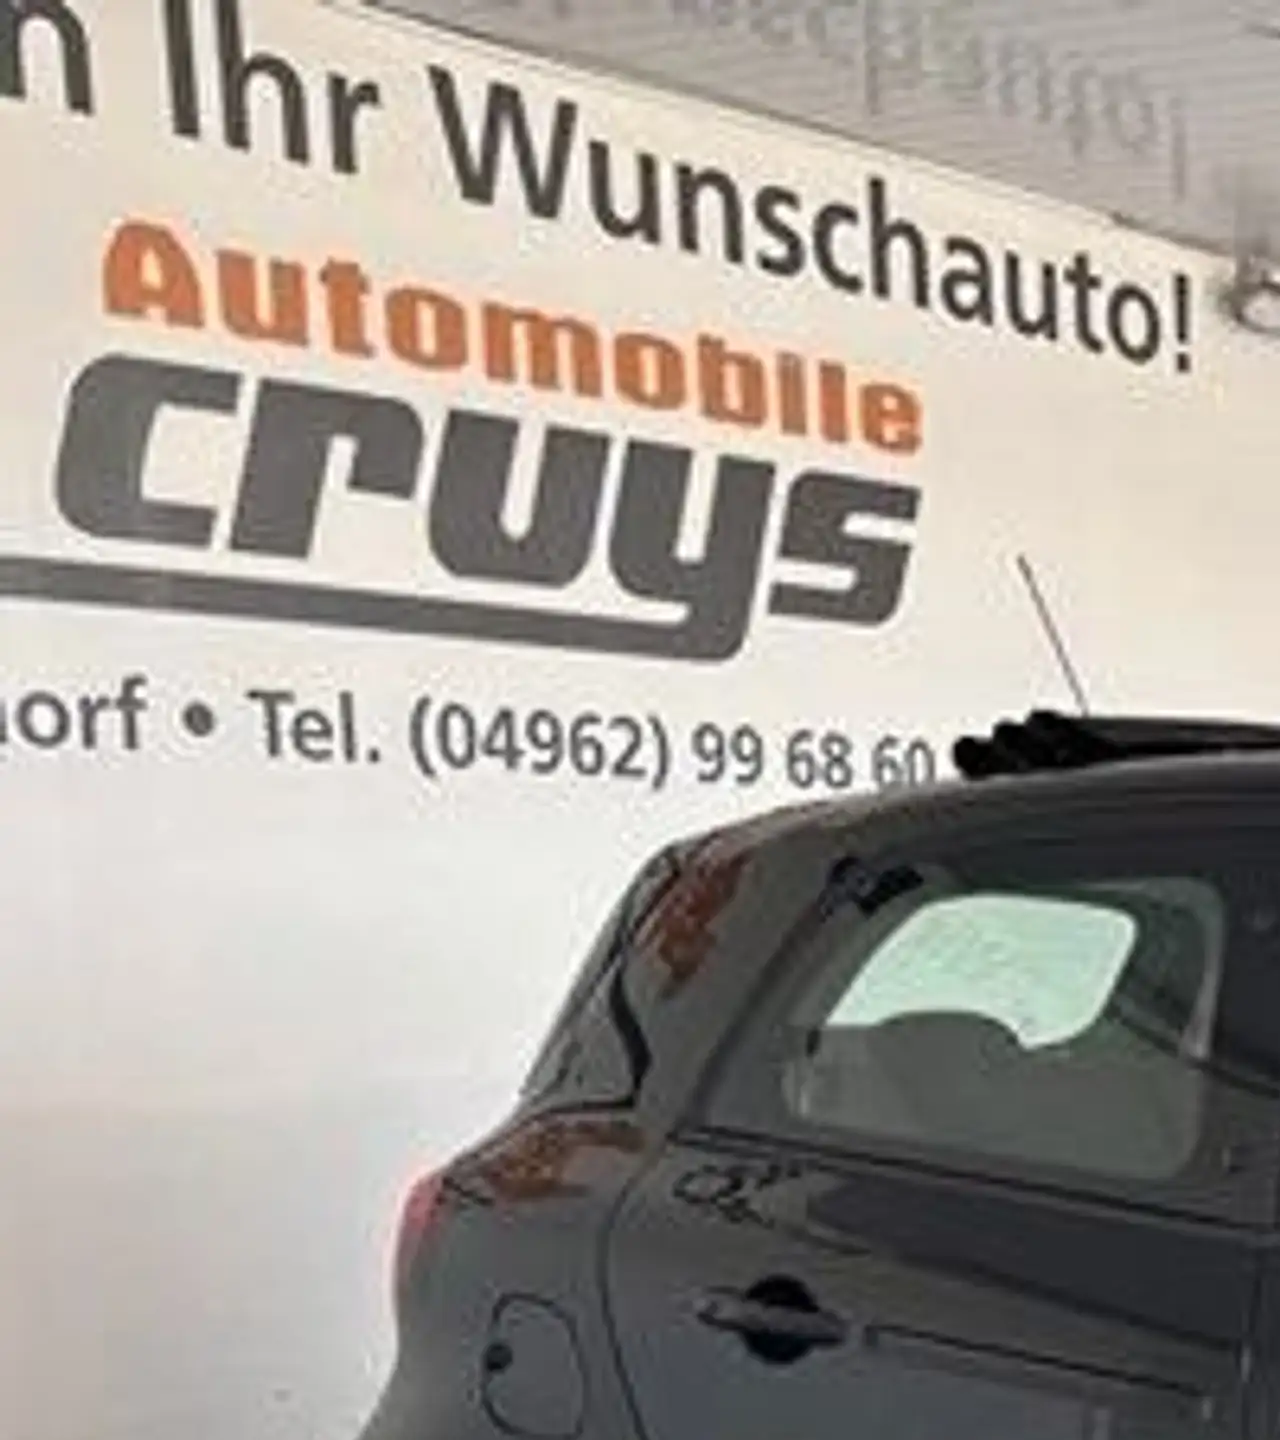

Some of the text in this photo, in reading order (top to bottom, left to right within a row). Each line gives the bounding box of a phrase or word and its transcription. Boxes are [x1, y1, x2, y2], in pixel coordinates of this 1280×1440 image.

[164, 0, 381, 174] Ihr
[428, 65, 1190, 372] Wunschauto!
[103, 222, 921, 453] Automobile
[53, 353, 922, 663] cruys
[0, 675, 936, 790] orf Tel. (04962) 99 68 60
